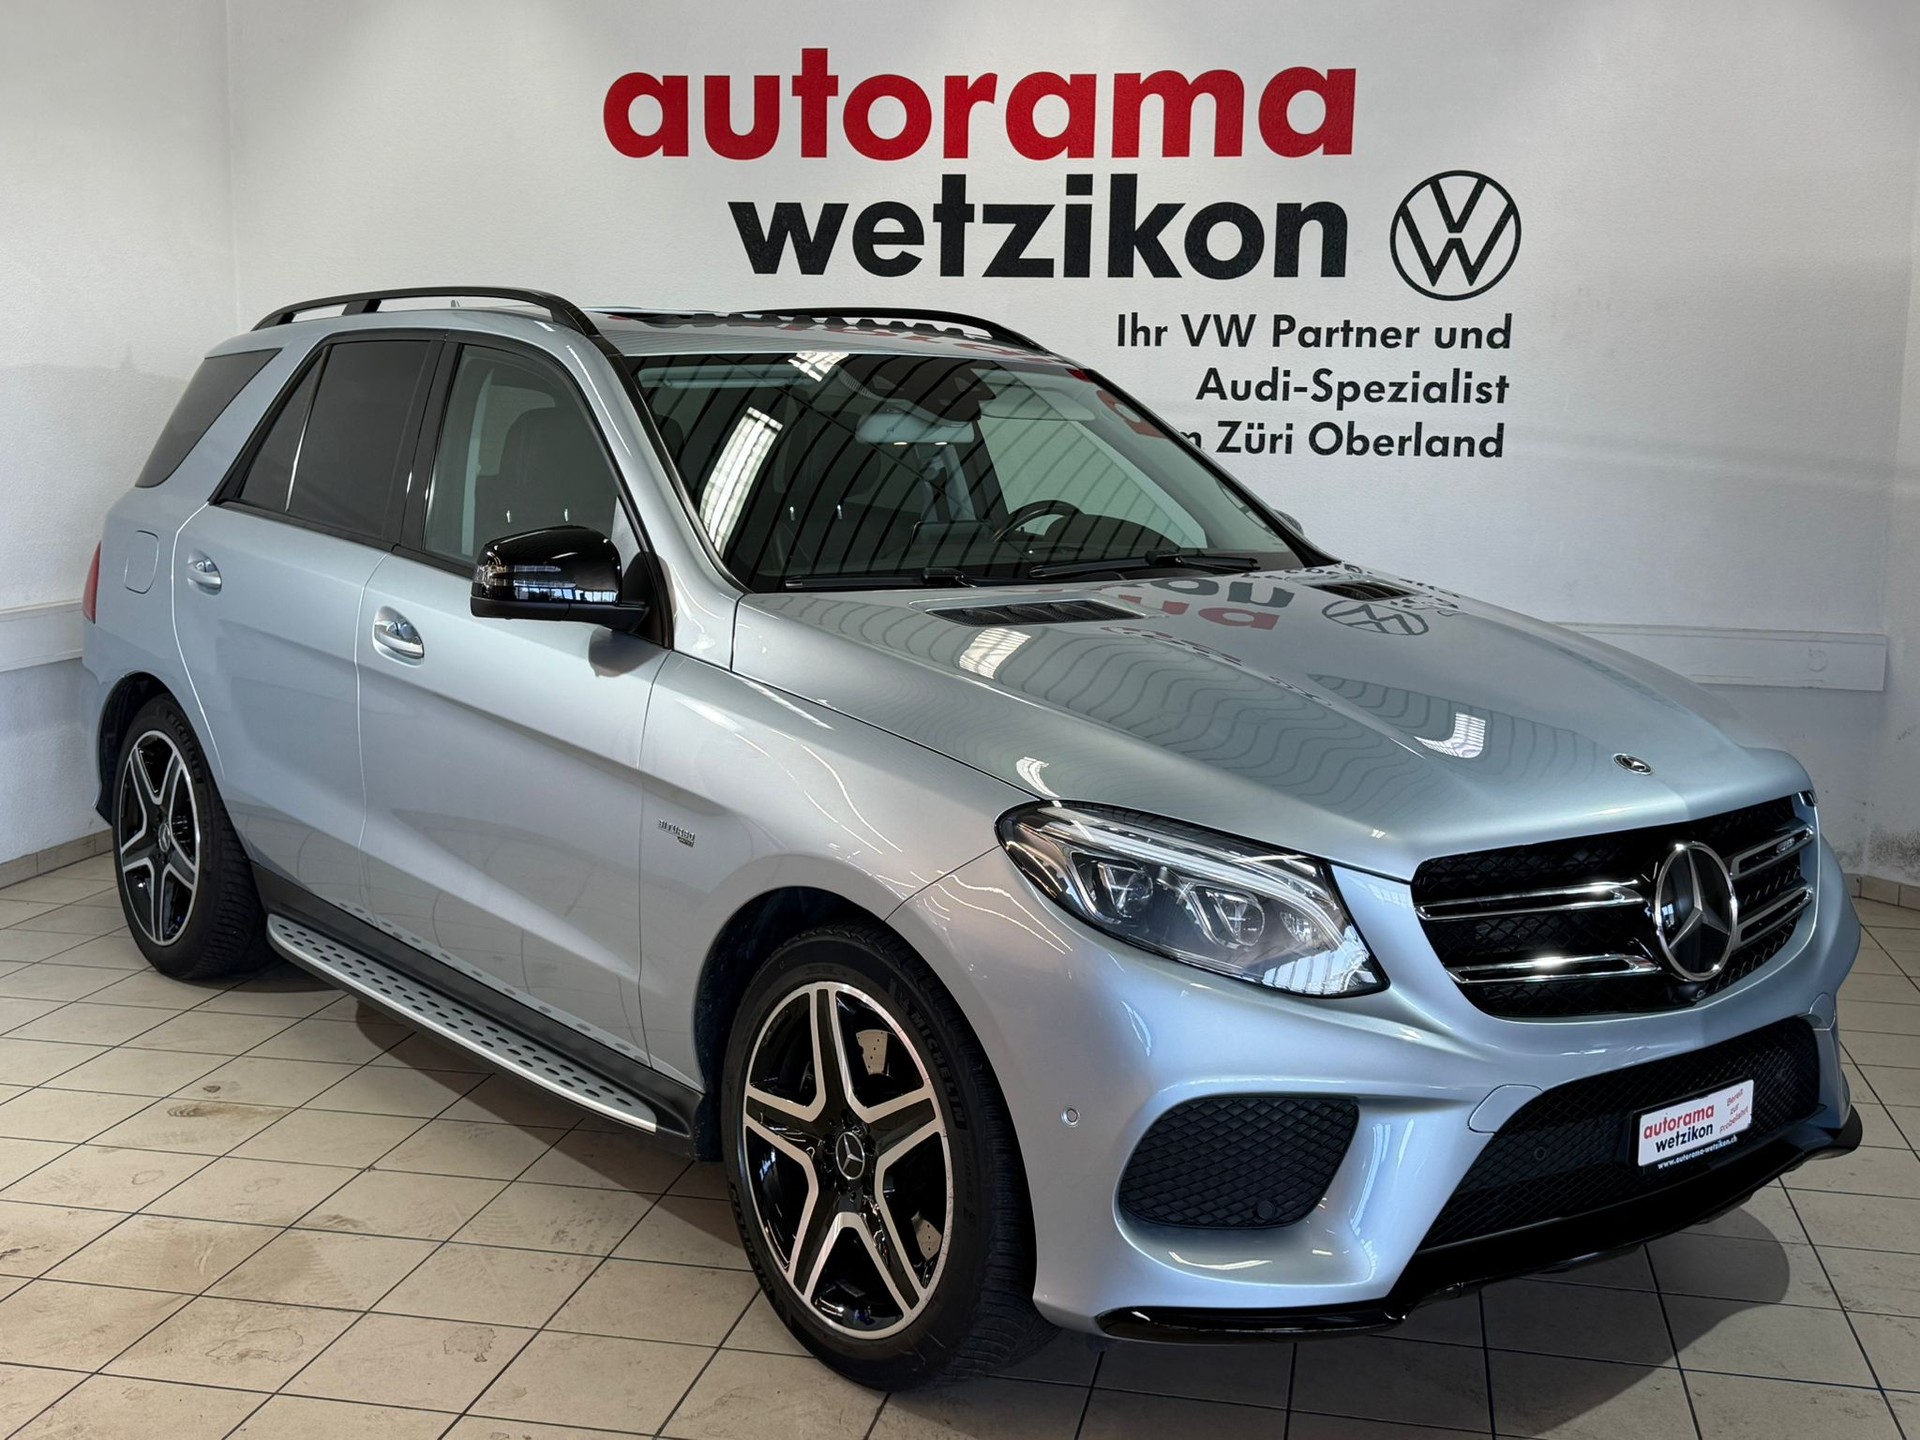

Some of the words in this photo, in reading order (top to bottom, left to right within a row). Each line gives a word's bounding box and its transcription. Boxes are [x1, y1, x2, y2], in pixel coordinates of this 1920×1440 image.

[604, 48, 1356, 161] autorama
[728, 174, 1347, 280] wetzikon
[1390, 170, 1521, 301] VW
[1118, 312, 1167, 347] Ihr
[1181, 313, 1256, 347] VW
[1273, 314, 1419, 348] Partner
[1435, 313, 1512, 349] und
[1196, 367, 1510, 410] Audi-Spezialist
[1216, 420, 1293, 455] Züri
[1309, 420, 1505, 457] Oberland
[910, 1009, 968, 1130] MICHELIN
[1643, 1104, 1715, 1139] autorama
[1655, 1123, 1713, 1153] wetzikon
